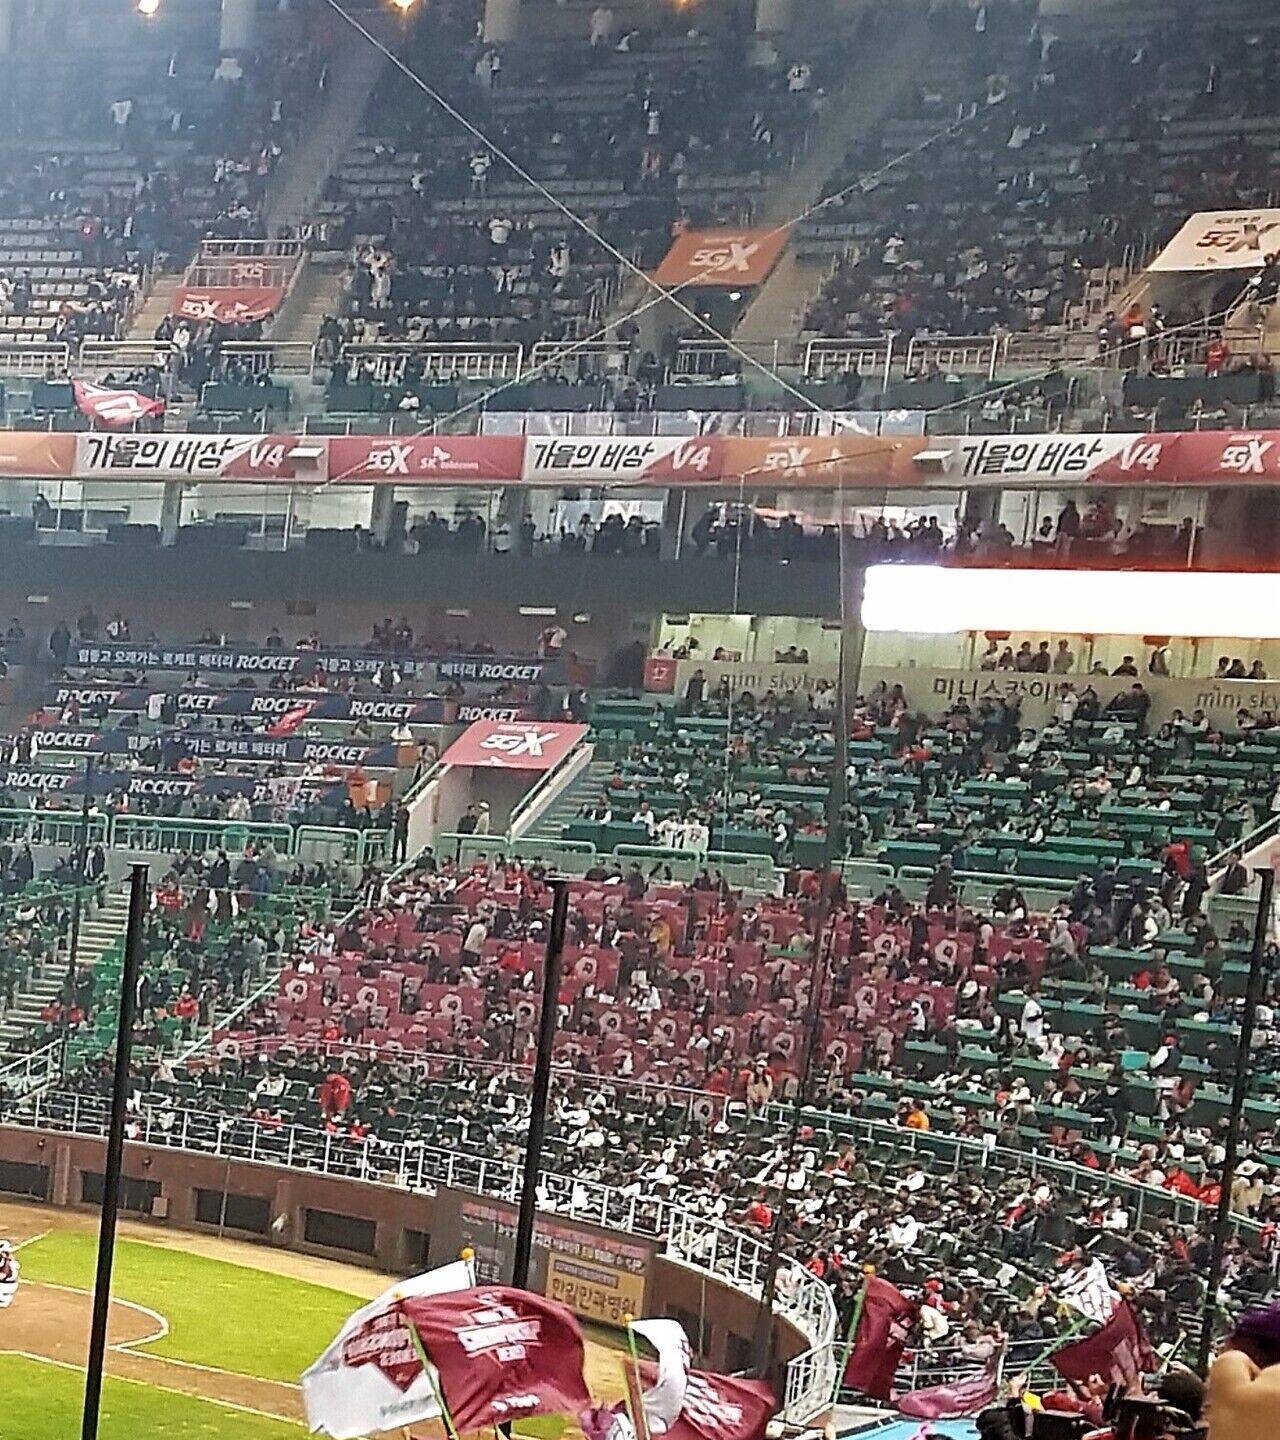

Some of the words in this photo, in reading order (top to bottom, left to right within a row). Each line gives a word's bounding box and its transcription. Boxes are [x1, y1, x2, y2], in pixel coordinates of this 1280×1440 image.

[690, 243, 759, 272] 5GX
[88, 437, 168, 469] 가을의
[170, 437, 237, 470] 비상
[248, 443, 286, 469] V4
[366, 444, 414, 474] 5GX
[534, 440, 596, 469] 가을의
[603, 442, 658, 472] 비상
[670, 443, 712, 472] V4
[962, 439, 1038, 476] 가을의
[1039, 438, 1104, 476] 비상
[1117, 441, 1163, 472] V4
[1221, 441, 1277, 474] 5GX
[235, 655, 300, 671] ROCKET
[479, 663, 543, 681] ROCKET
[1196, 687, 1240, 708] mini
[349, 701, 417, 718] ROCKET
[458, 706, 521, 722] ROCKET
[32, 731, 96, 748] ROCKET
[480, 731, 559, 755] 5GX
[303, 744, 371, 762] ROCKET
[5, 772, 71, 789] ROCKET
